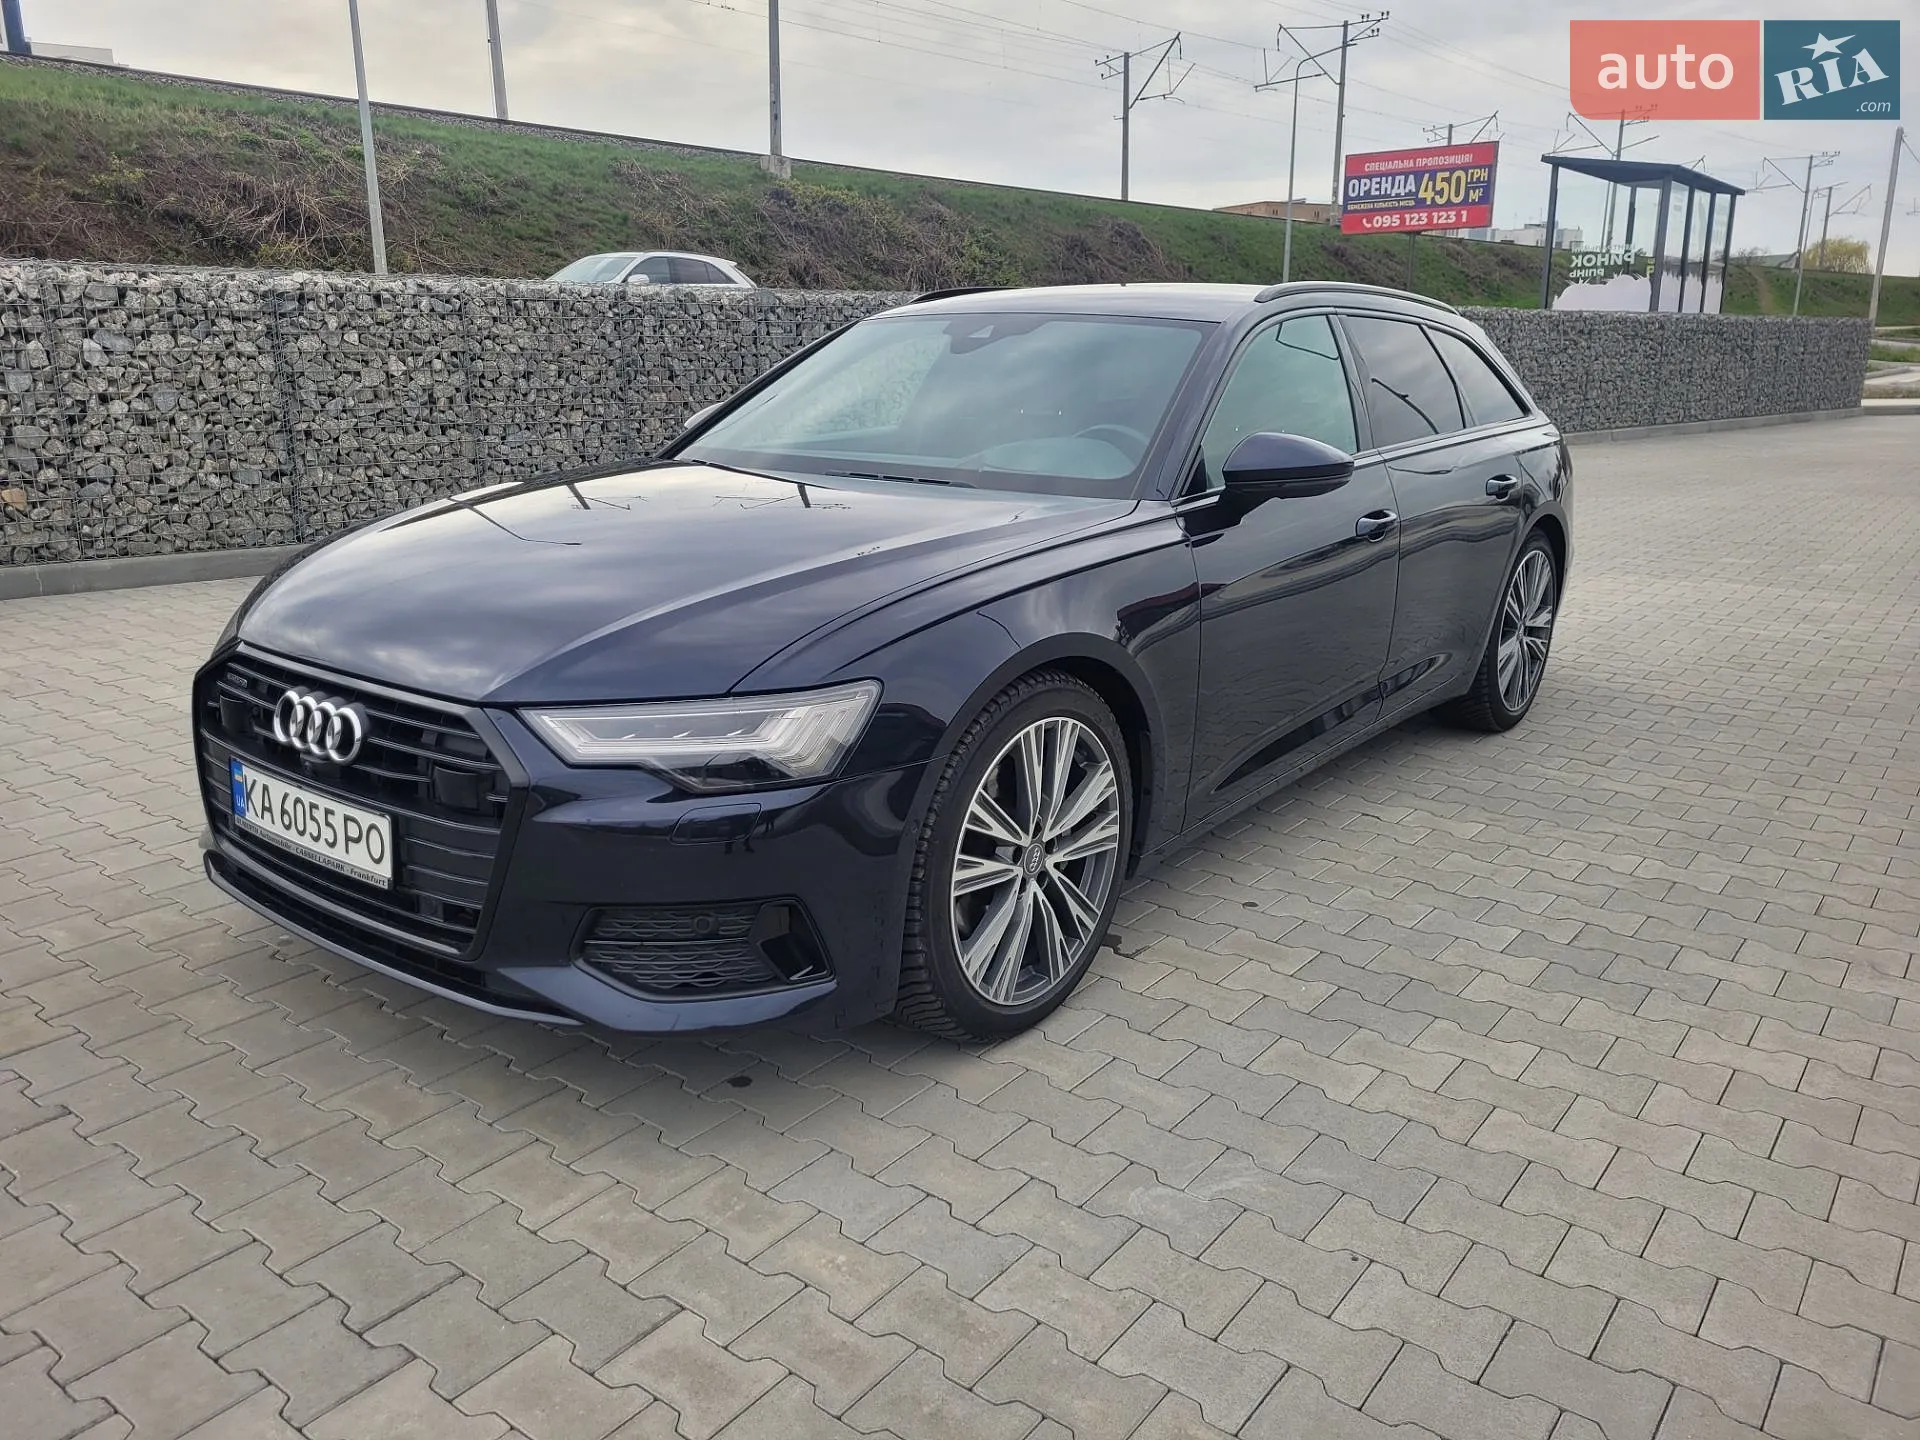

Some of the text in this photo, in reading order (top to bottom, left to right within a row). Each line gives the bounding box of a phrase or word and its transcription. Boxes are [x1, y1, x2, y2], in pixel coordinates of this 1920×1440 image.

[1364, 161, 1414, 172] СПЕЦІАЛЬНА
[1467, 168, 1489, 182] ГРН
[1348, 170, 1467, 205] ОРЕНДА 450
[1372, 210, 1468, 228] 095 123 123 1
[236, 795, 245, 808] UA
[244, 774, 275, 825] KA
[280, 791, 338, 849] 6055
[343, 813, 385, 865] PO
[350, 867, 387, 887] Frankfurt
